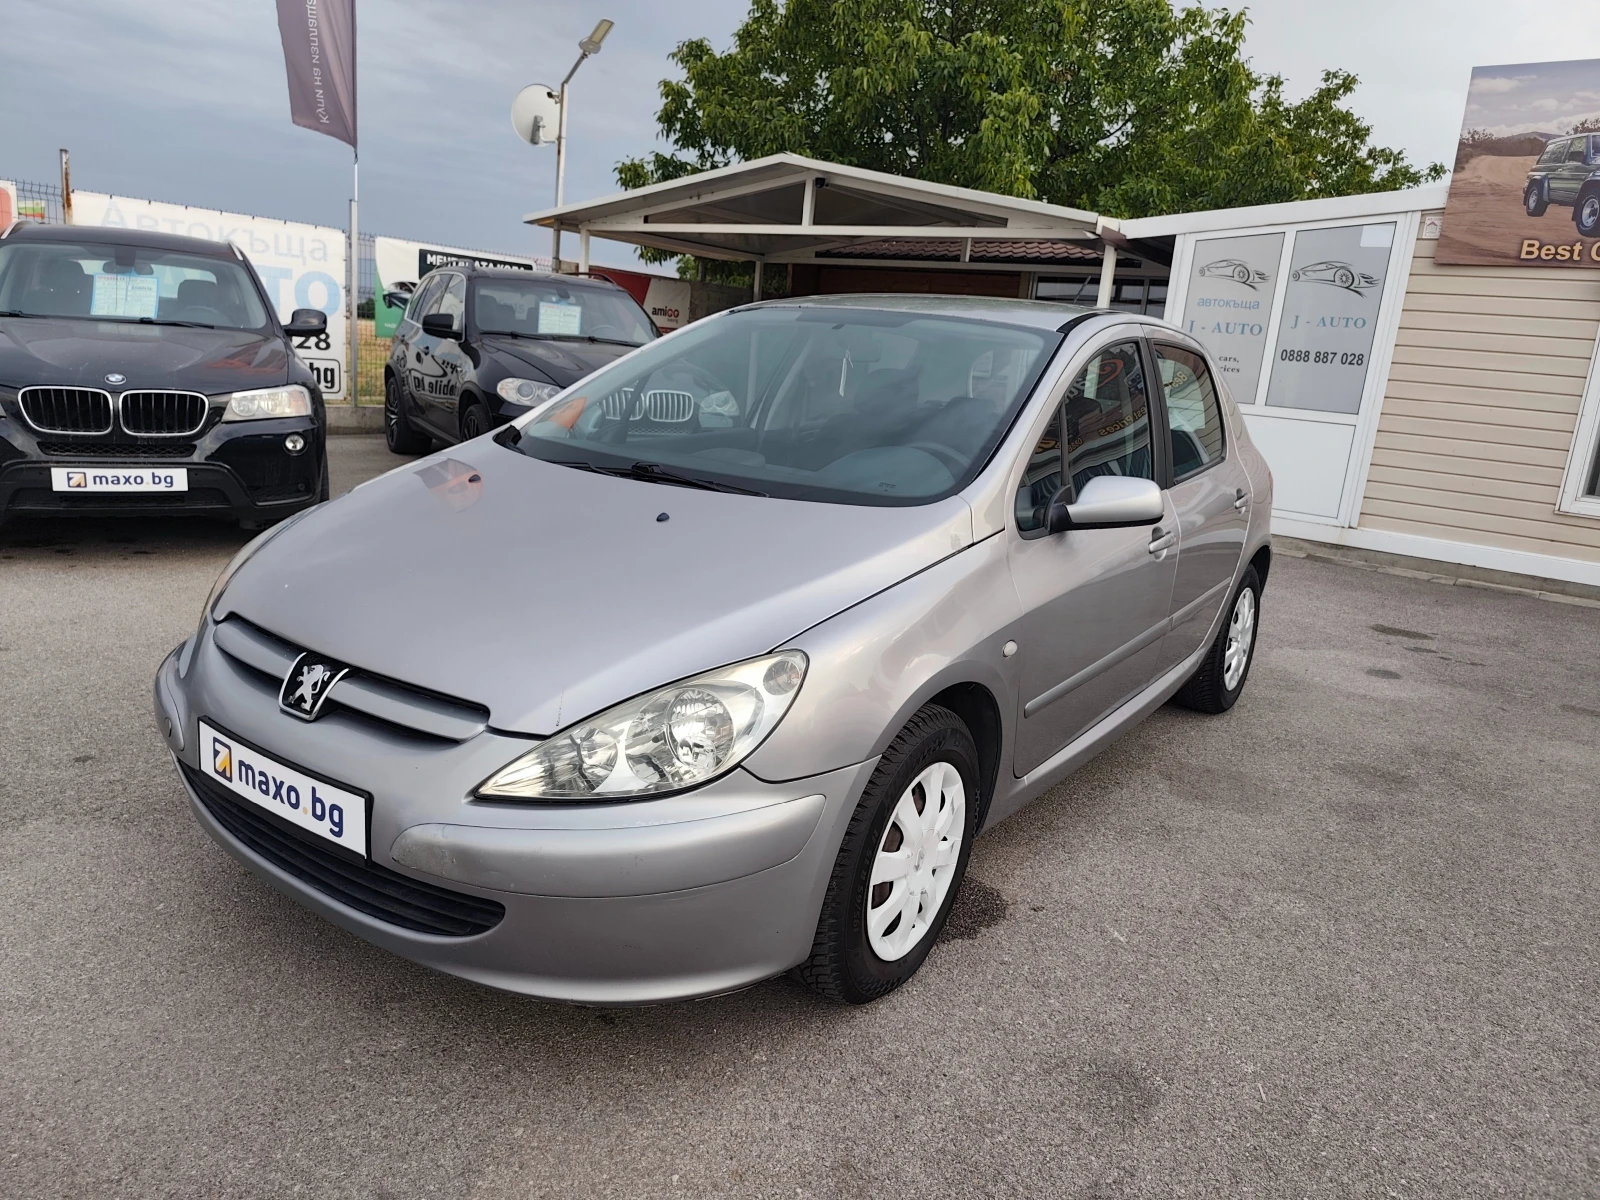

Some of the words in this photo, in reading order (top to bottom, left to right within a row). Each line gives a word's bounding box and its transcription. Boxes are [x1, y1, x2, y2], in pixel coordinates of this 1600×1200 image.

[1520, 239, 1583, 261] Best
[1197, 297, 1260, 311] автокъща
[1212, 321, 1263, 336] AUTO
[1290, 315, 1300, 330] J
[1316, 316, 1367, 330] AUTO
[291, 332, 331, 351] 28
[1218, 356, 1240, 364] cars,
[1280, 349, 1310, 363] 0888
[1313, 350, 1338, 365] 887
[1340, 352, 1365, 367] 028
[93, 472, 174, 488] maxo.bg
[238, 759, 344, 839] maxo.bg
